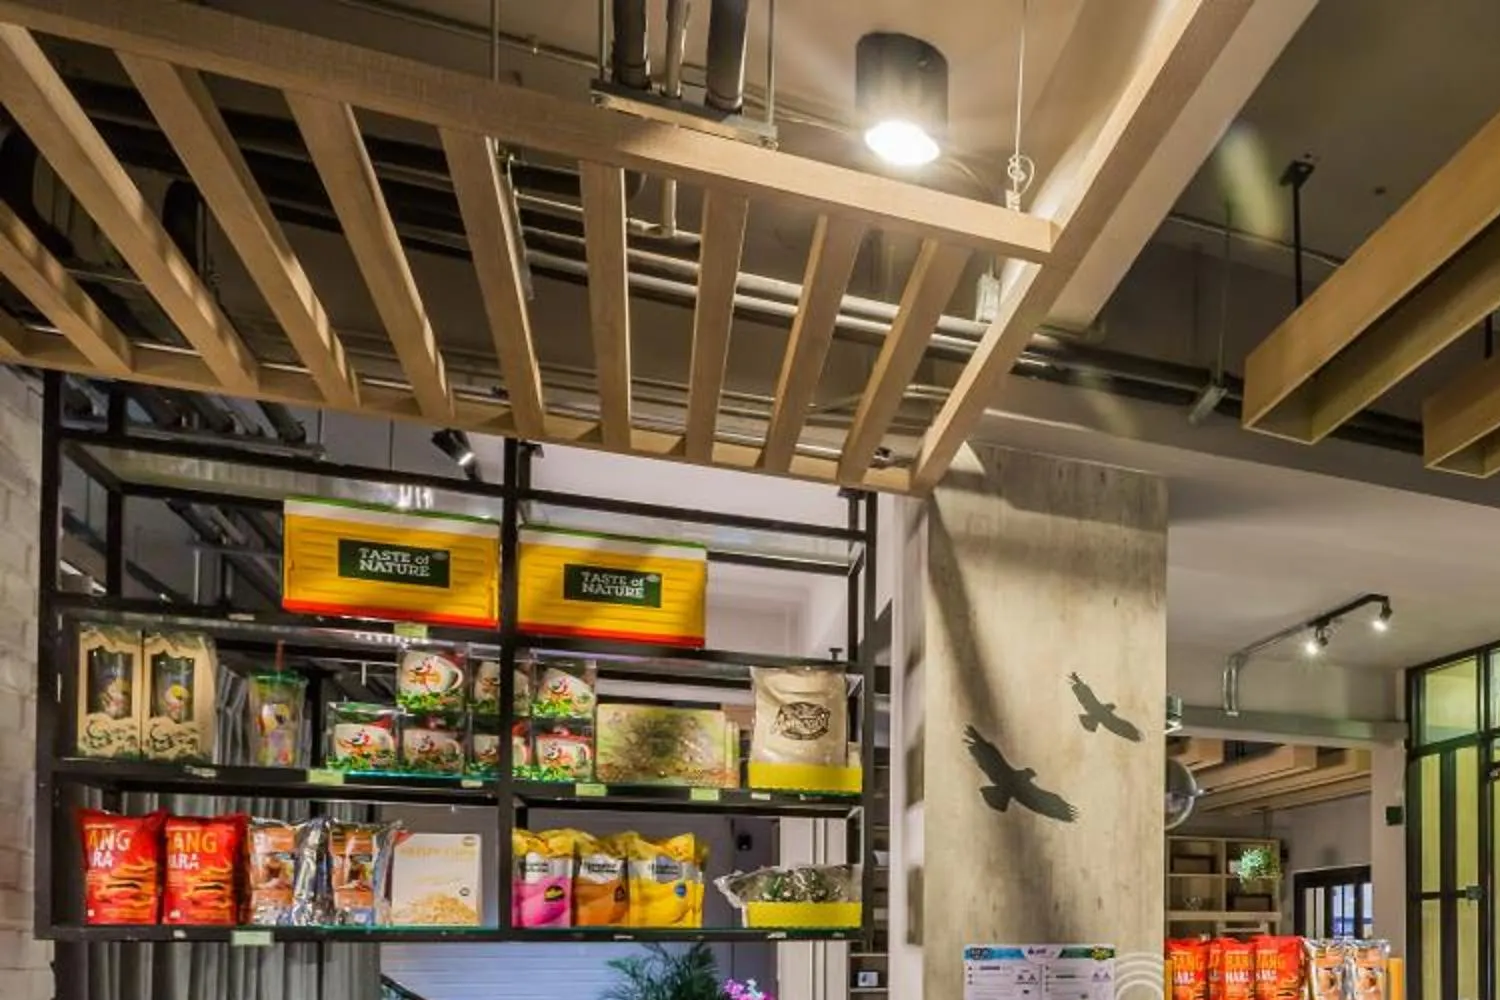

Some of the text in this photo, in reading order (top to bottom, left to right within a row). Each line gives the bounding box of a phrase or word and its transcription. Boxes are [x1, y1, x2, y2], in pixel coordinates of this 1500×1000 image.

[358, 547, 431, 565] TASTE of
[359, 559, 431, 577] NATURE
[580, 571, 645, 587] TASTE of
[580, 581, 645, 599] NATURE
